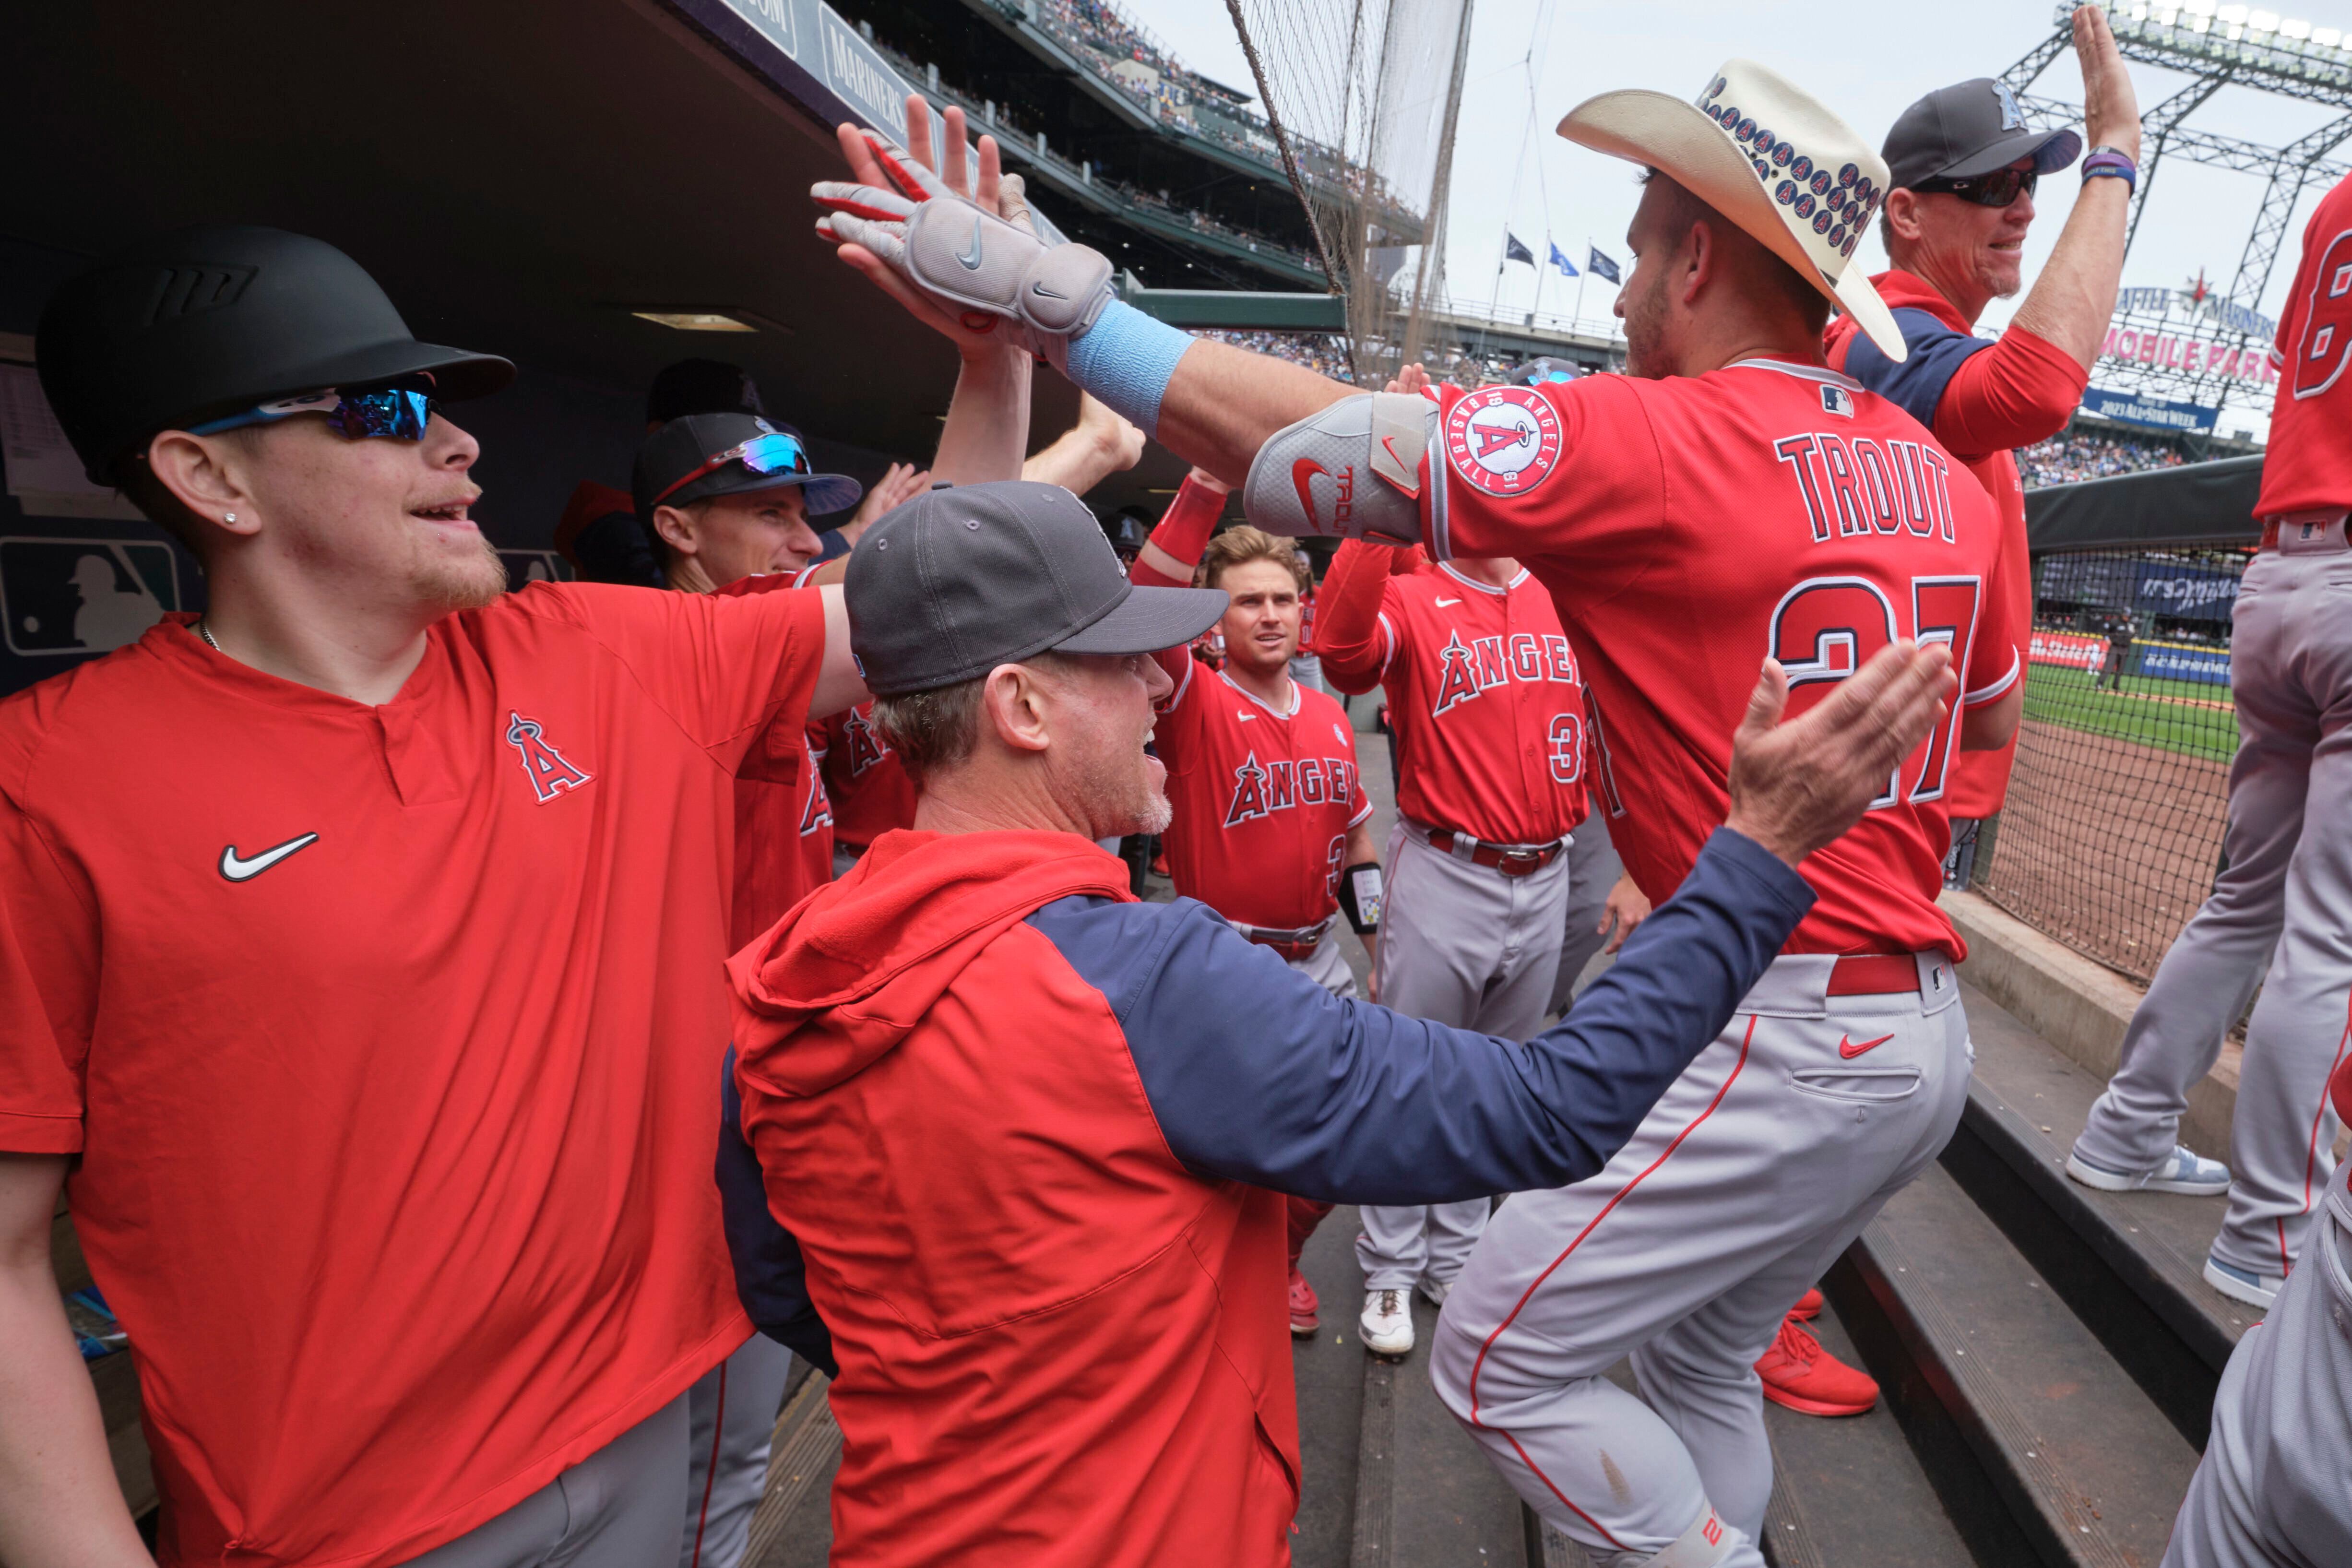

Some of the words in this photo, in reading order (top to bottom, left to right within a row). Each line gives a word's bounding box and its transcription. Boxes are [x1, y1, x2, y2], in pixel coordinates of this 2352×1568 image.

[829, 23, 906, 135] MARINERS
[2115, 288, 2171, 310] ATTLE
[2100, 328, 2201, 369] MOBILE
[1486, 392, 1504, 407] 19
[1523, 395, 1556, 469] ANGELS
[2100, 400, 2125, 417] 2023
[1450, 398, 1491, 487] BASEBALL
[1502, 470, 1520, 489] 61
[1774, 433, 1955, 544] TROUT
[1432, 628, 1582, 717] ANGE
[1768, 576, 1981, 810] 27
